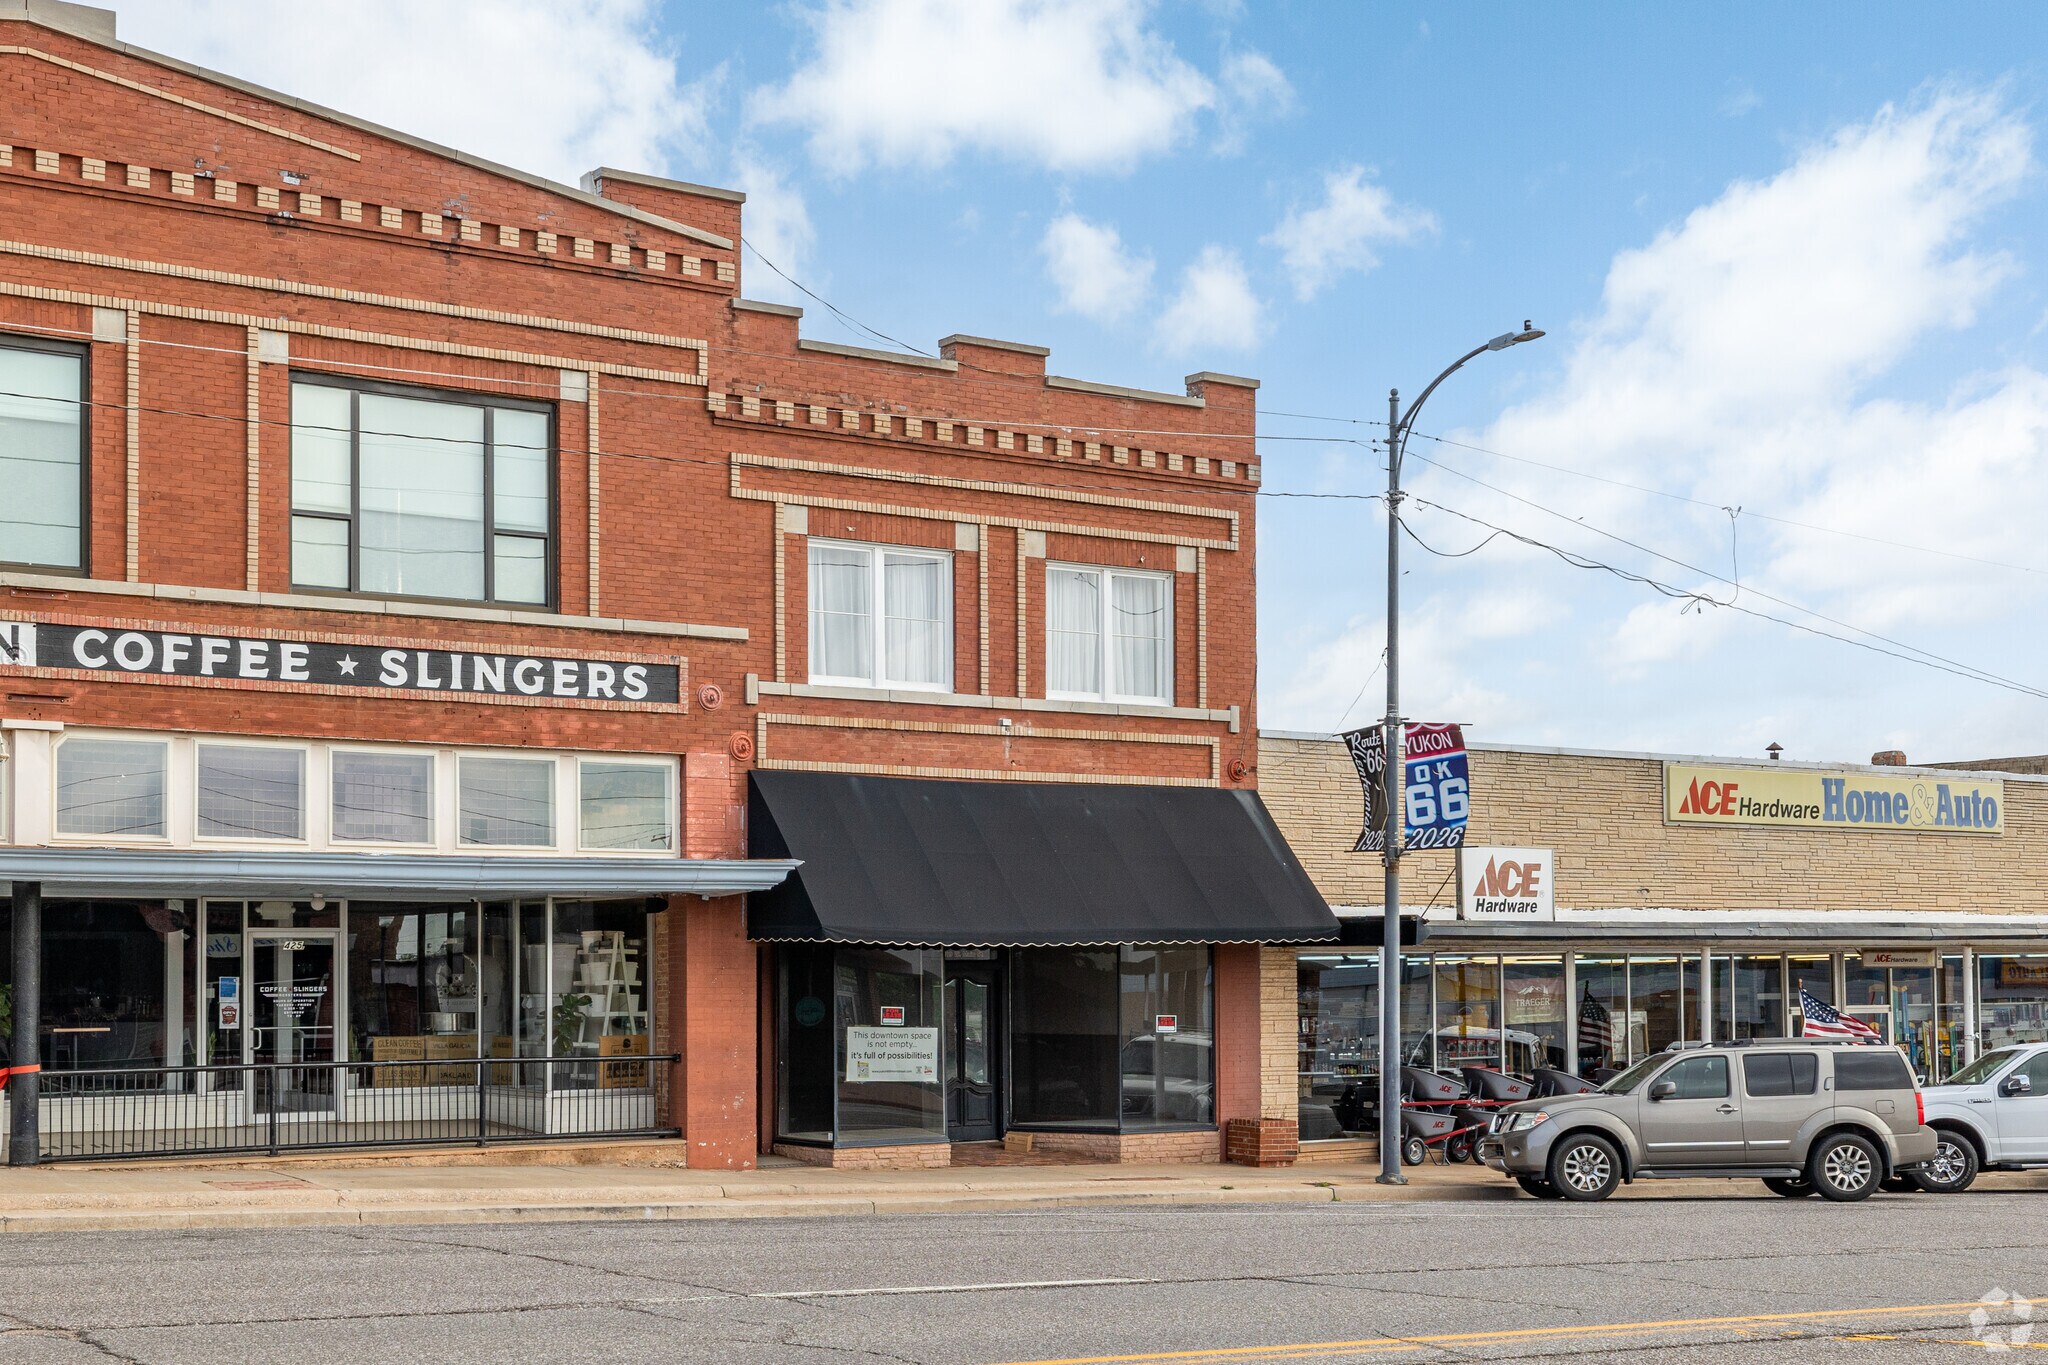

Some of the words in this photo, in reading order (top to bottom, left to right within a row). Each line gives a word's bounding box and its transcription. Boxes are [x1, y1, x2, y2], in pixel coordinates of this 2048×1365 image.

[73, 629, 310, 681] COFFEE
[379, 649, 649, 700] SLINGERS
[1346, 730, 1382, 752] Route
[1405, 732, 1454, 754] YUKON
[1366, 748, 1383, 773] 66
[1414, 761, 1453, 783] OK
[1405, 778, 1469, 826] 66
[1678, 776, 1738, 815] ACE
[1739, 797, 1820, 819] Hardware
[1821, 778, 1909, 825] Home
[1909, 784, 1934, 826] &
[1935, 784, 1998, 828] Auto
[1356, 830, 1386, 851] 1926
[1473, 854, 1541, 897] ACE
[1476, 898, 1538, 913] Hardware
[284, 941, 304, 950] 425
[1873, 953, 1891, 962] ACE
[1515, 998, 1550, 1007] TRAEGER
[854, 1031, 868, 1039] This
[870, 1031, 909, 1039] downtown
[887, 1052, 933, 1060] possibilities!
[1439, 1084, 1453, 1093] ACE
[1507, 1084, 1521, 1093] ACE
